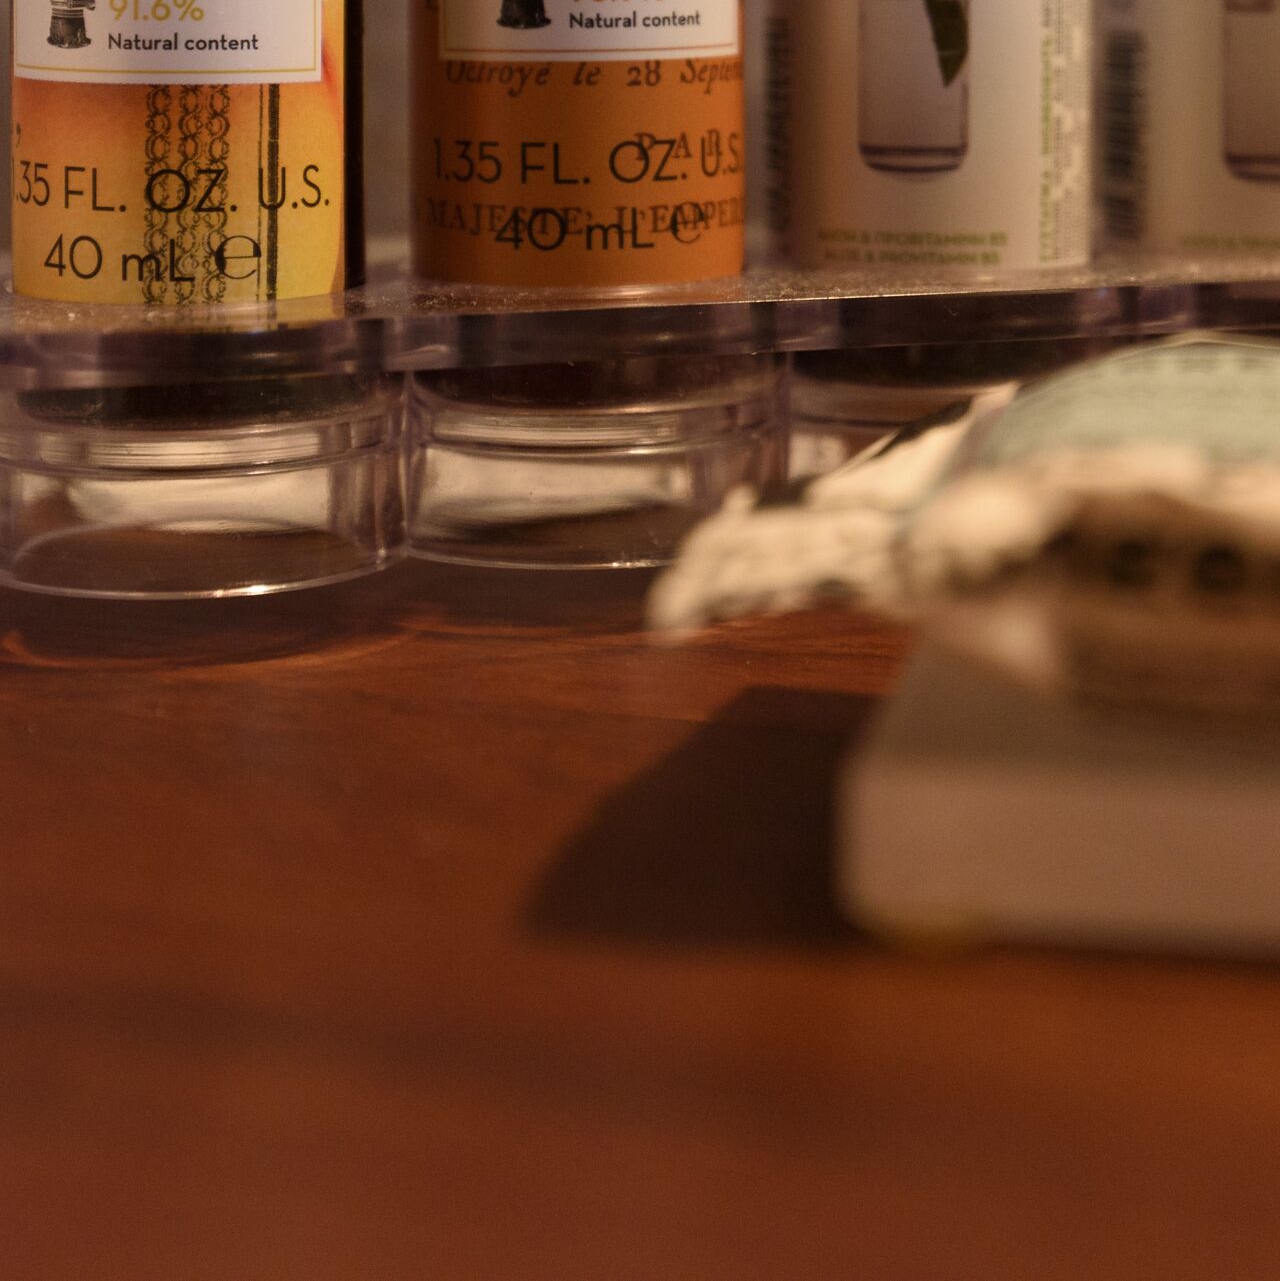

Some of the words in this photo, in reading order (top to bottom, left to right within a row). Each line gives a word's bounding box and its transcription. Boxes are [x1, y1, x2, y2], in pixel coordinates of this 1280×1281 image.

[108, 33, 178, 51] Natural
[184, 33, 259, 51] content
[569, 10, 637, 30] Natural
[642, 10, 701, 28] content
[571, 61, 602, 86] le
[626, 60, 661, 86] 28
[433, 137, 502, 184] 1.35
[520, 142, 590, 185] FL.
[609, 139, 688, 184] OZ.
[63, 165, 127, 212] FL.
[144, 169, 238, 213] OZ.
[258, 164, 330, 210] U.S.
[496, 207, 568, 251] 40
[586, 207, 655, 251] mL
[43, 233, 102, 280] 40
[121, 239, 195, 282] mL
